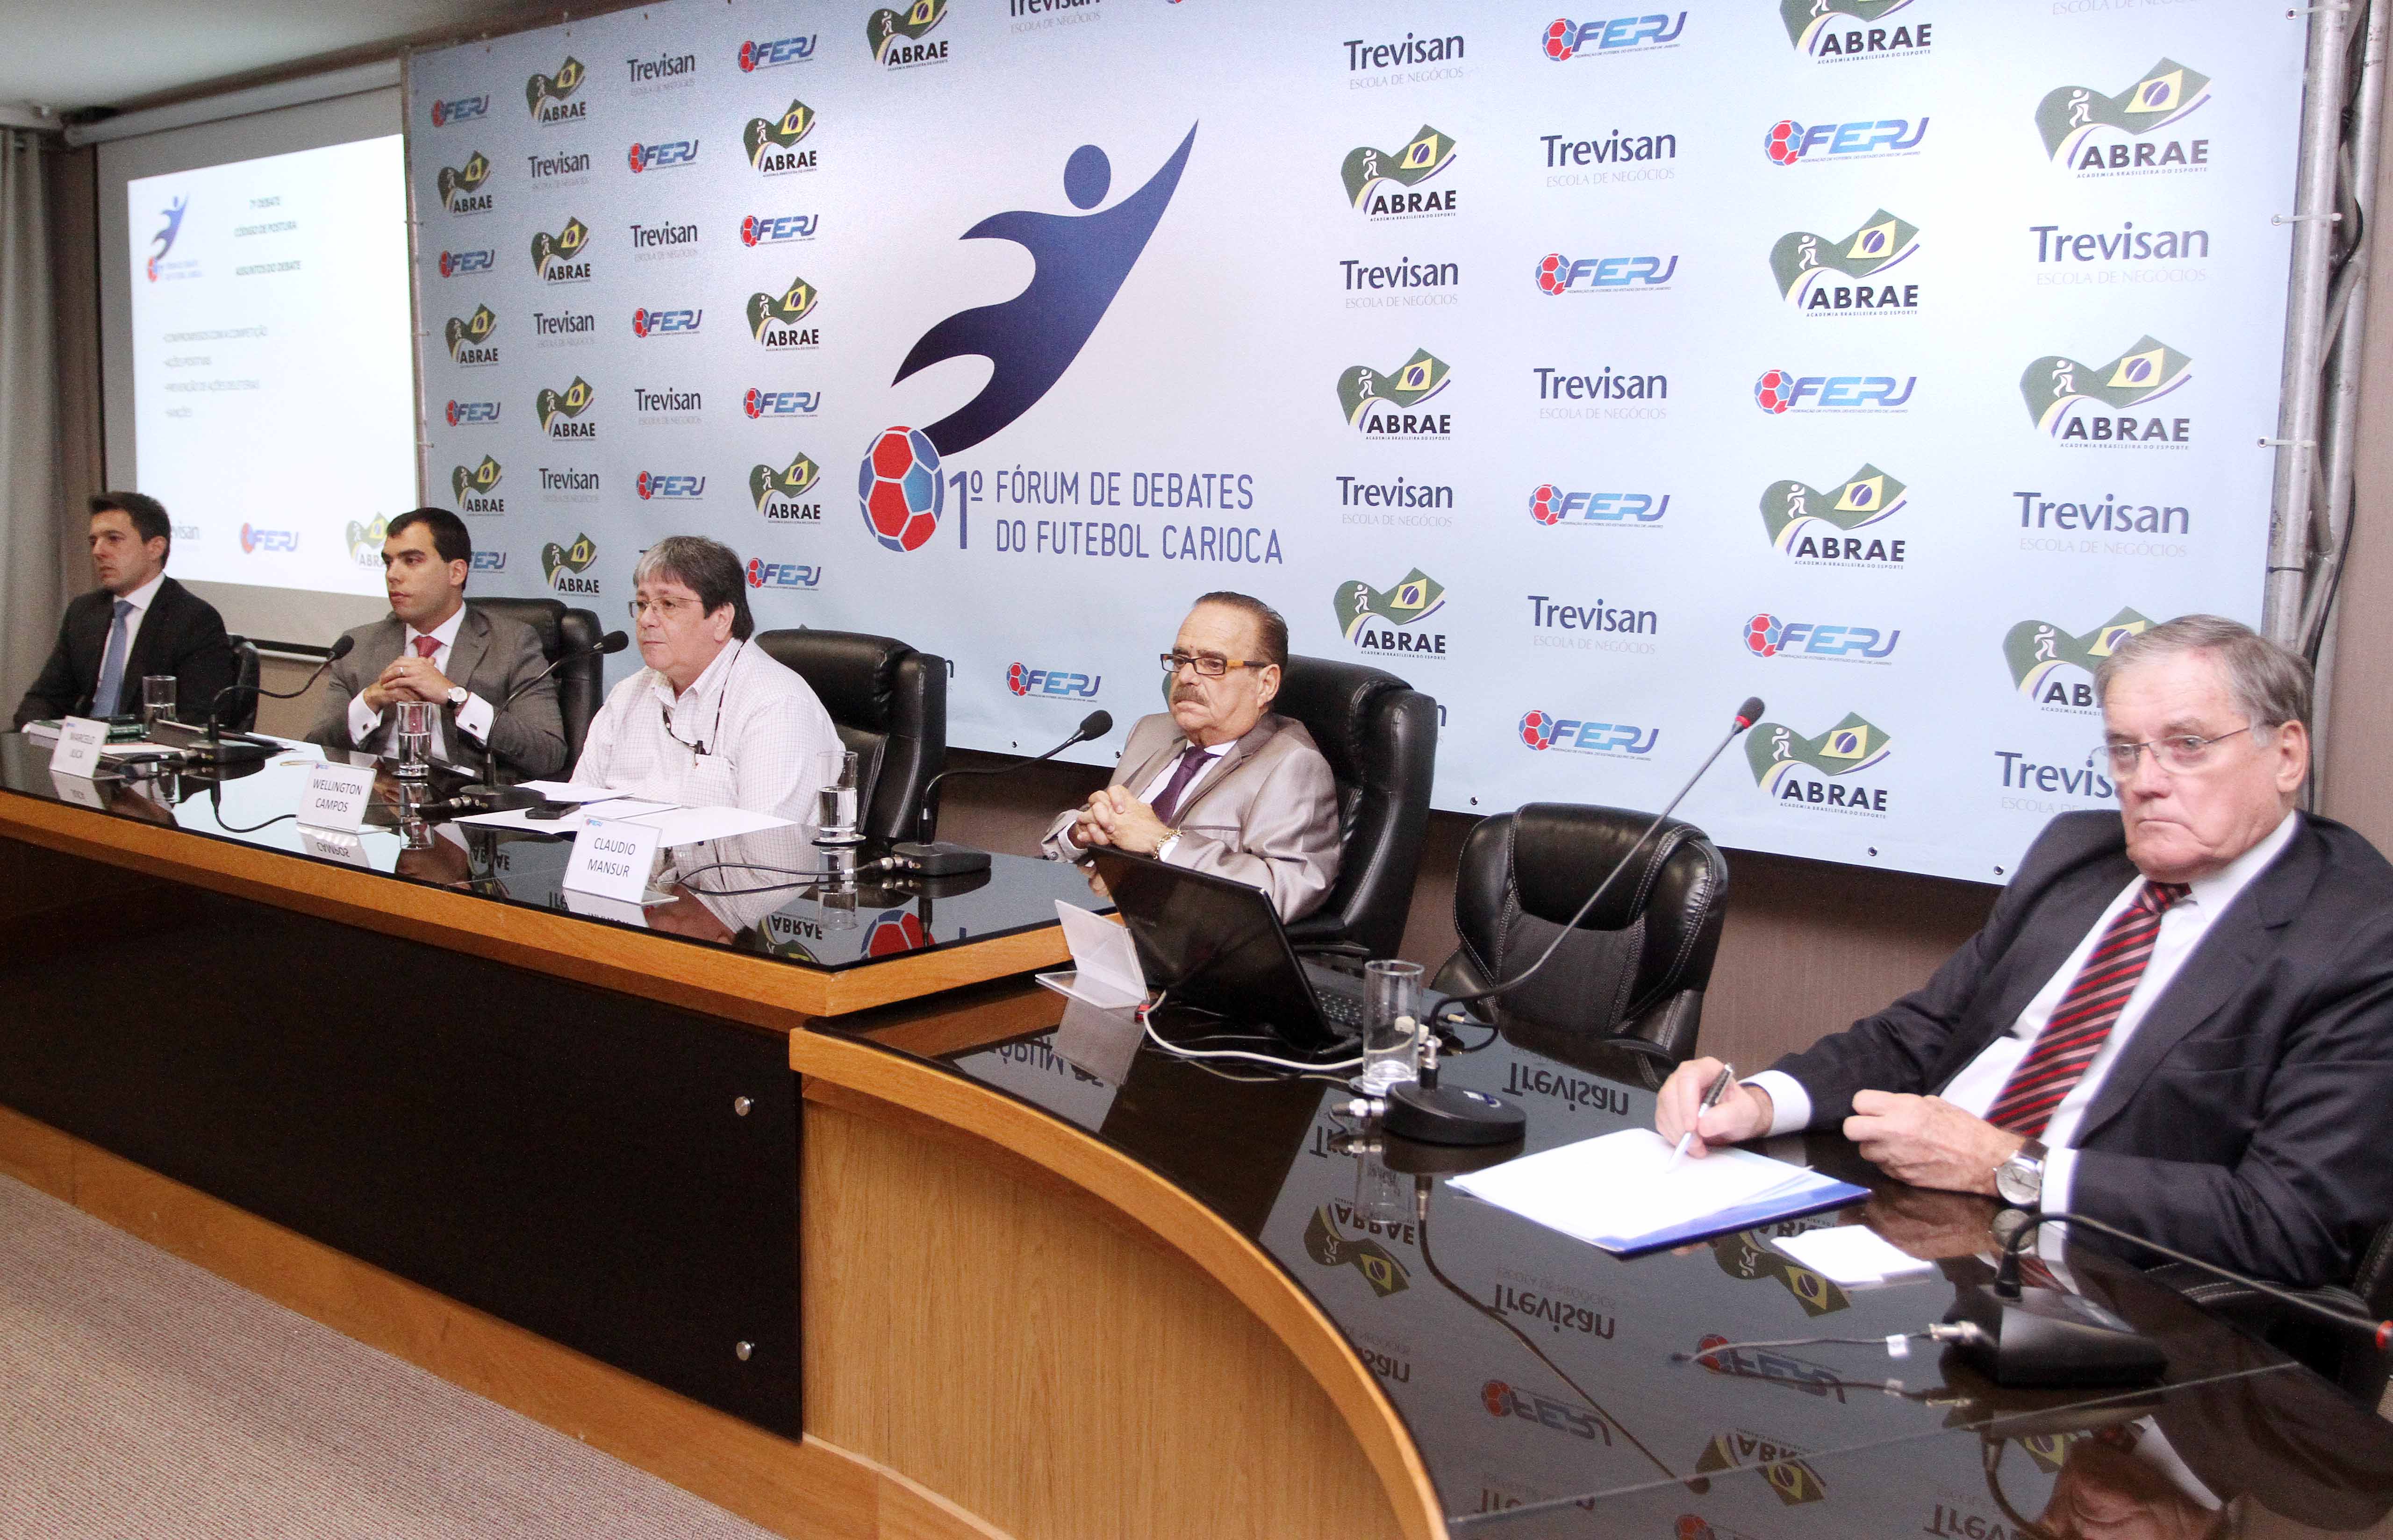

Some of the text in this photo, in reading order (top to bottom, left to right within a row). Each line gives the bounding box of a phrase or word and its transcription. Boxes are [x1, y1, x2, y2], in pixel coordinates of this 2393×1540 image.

[1571, 11, 1688, 53] FERJ
[1819, 23, 1932, 57] ABRAE
[754, 34, 817, 65] FERJ
[888, 41, 948, 65] ABRAE
[1344, 32, 1464, 71] Trevisan
[627, 52, 695, 82] Trevisan
[1350, 75, 1387, 89] ESCOLA
[1391, 73, 1404, 85] DE
[444, 95, 489, 120] FERJ
[542, 101, 586, 122] ABRAE
[1540, 129, 1676, 167] Trevisan
[1797, 117, 1930, 157] FERJ
[528, 151, 590, 178] Trevisan
[643, 140, 699, 167] FERJ
[763, 150, 817, 172] ABRAE
[2078, 139, 2208, 170] ABRAE
[1547, 174, 1589, 187] ESCOLA
[1593, 172, 1607, 185] DE
[453, 194, 492, 214] ABRAE
[1370, 190, 1456, 215] ABRAE
[630, 221, 698, 248] Trevisan
[757, 214, 818, 241] FERJ
[2029, 221, 2208, 263] Trevisan
[452, 250, 495, 272] FERJ
[548, 263, 591, 280] ABRAE
[1340, 256, 1459, 290] Trevisan
[1565, 256, 1679, 288] FERJ
[1346, 296, 1383, 308] ESCOLA
[1386, 296, 1398, 307] DE
[1807, 285, 1918, 309] ABRAE
[534, 310, 594, 335] Trevisan
[648, 309, 702, 333] FERJ
[767, 329, 819, 346] ABRAE
[460, 348, 498, 364] ABRAE
[1533, 366, 1667, 399] Trevisan
[1786, 376, 1917, 406] FERJ
[634, 387, 701, 411] Trevisan
[760, 392, 821, 413] FERJ
[458, 402, 501, 421] FERJ
[1540, 408, 1581, 419] ESCOLA
[1585, 408, 1599, 419] DE
[552, 422, 595, 438] ABRAE
[1366, 414, 1451, 434] ABRAE
[2061, 417, 2190, 442] ABRAE
[539, 468, 599, 490] Trevisan
[652, 476, 706, 496] FERJ
[997, 464, 1254, 510] FÓRUM DE DEBATES
[1336, 477, 1453, 508] Trevisan
[466, 499, 504, 512] ABRAE
[768, 503, 820, 520] ABRAE
[949, 470, 983, 549] 1º
[1557, 492, 1670, 522] FERJ
[2013, 492, 2189, 534] Trevisan
[1342, 513, 1378, 524] ESCOLA
[1382, 514, 1394, 525] DE
[254, 529, 299, 552] FERJ
[997, 519, 1283, 564] DO FUTEBOL CARIOCA
[1795, 537, 1906, 562] ABRAE
[359, 553, 385, 566] ABRA
[469, 552, 506, 570] ERJ
[558, 578, 599, 593] ABRAE
[762, 564, 821, 586] FERJ
[1527, 596, 1657, 635] Trevisan
[1361, 630, 1446, 654] ABRAE
[1533, 635, 1574, 649] ESCOLA
[1577, 638, 1591, 650] DE
[1775, 623, 1901, 657] FERJ
[1027, 670, 1101, 697] FERJ
[1548, 719, 1660, 754] FERJ
[1994, 751, 2113, 798] Trevis
[313, 778, 362, 796] WELLINGTON
[1781, 780, 1887, 812] ABRAE
[315, 798, 349, 813] CAMPOS
[1813, 806, 1847, 814] BRASILEIRA
[594, 837, 636, 856] CLAUDIO
[587, 859, 630, 878] MANSUR
